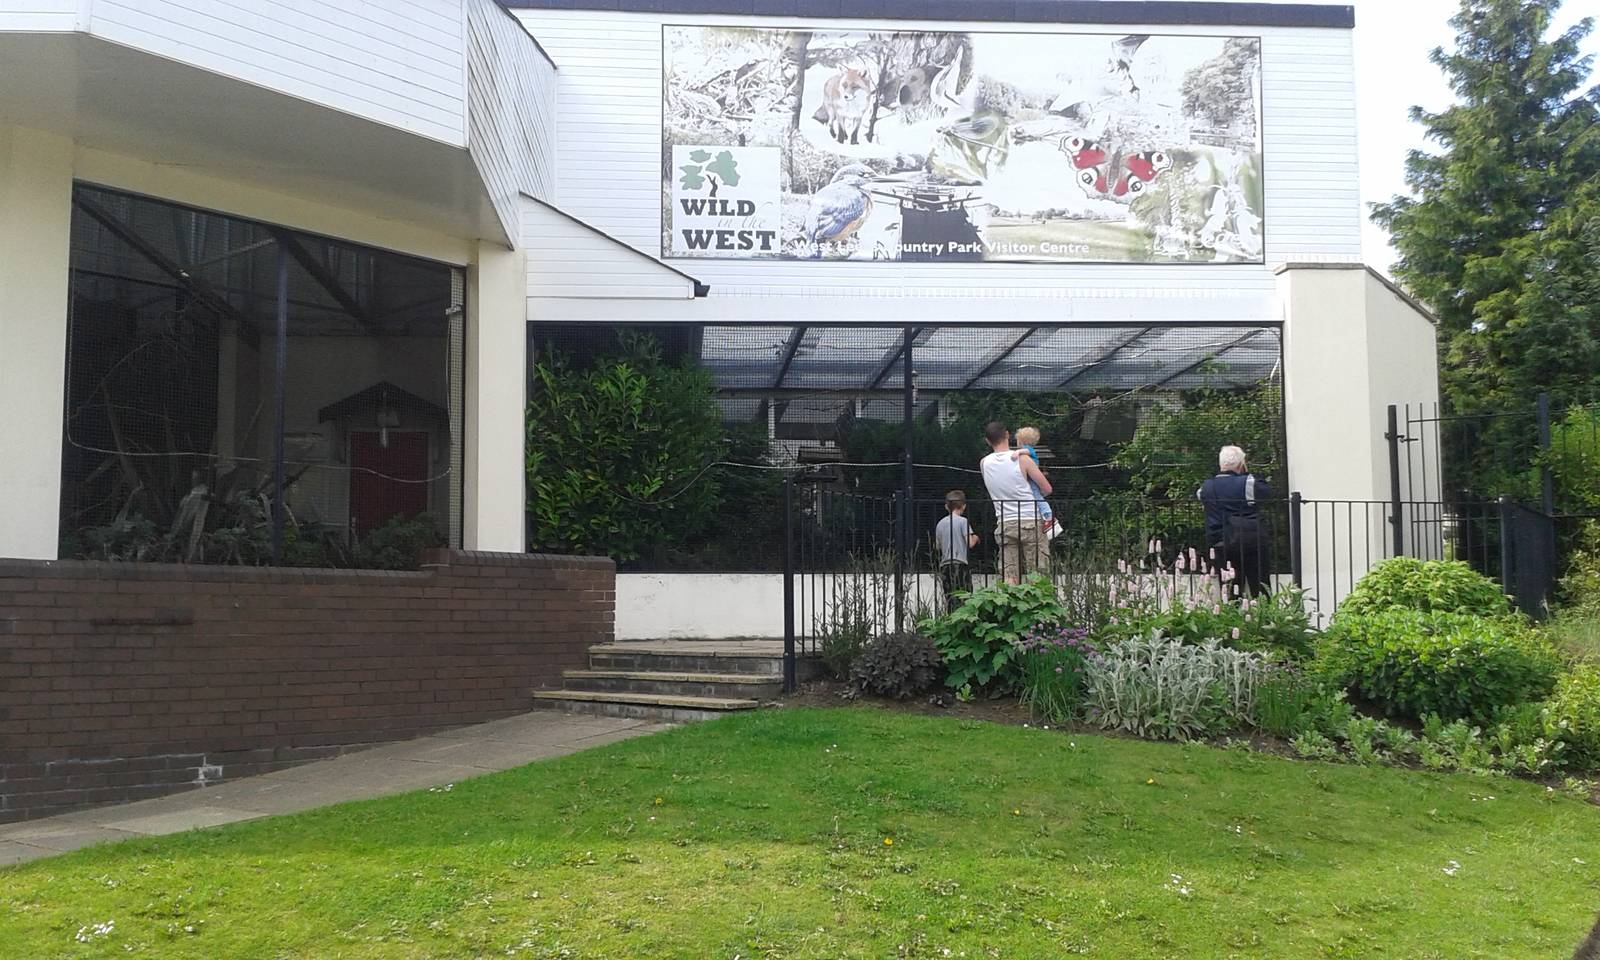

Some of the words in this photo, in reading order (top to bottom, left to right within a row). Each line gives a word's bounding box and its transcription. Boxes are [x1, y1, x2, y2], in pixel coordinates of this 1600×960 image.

[680, 199, 755, 216] WILD
[682, 229, 776, 250] WEST
[795, 240, 833, 254] West
[884, 241, 944, 256] ountry
[948, 241, 982, 253] Park
[986, 242, 1035, 254] Visitor
[1040, 242, 1090, 254] Centre
